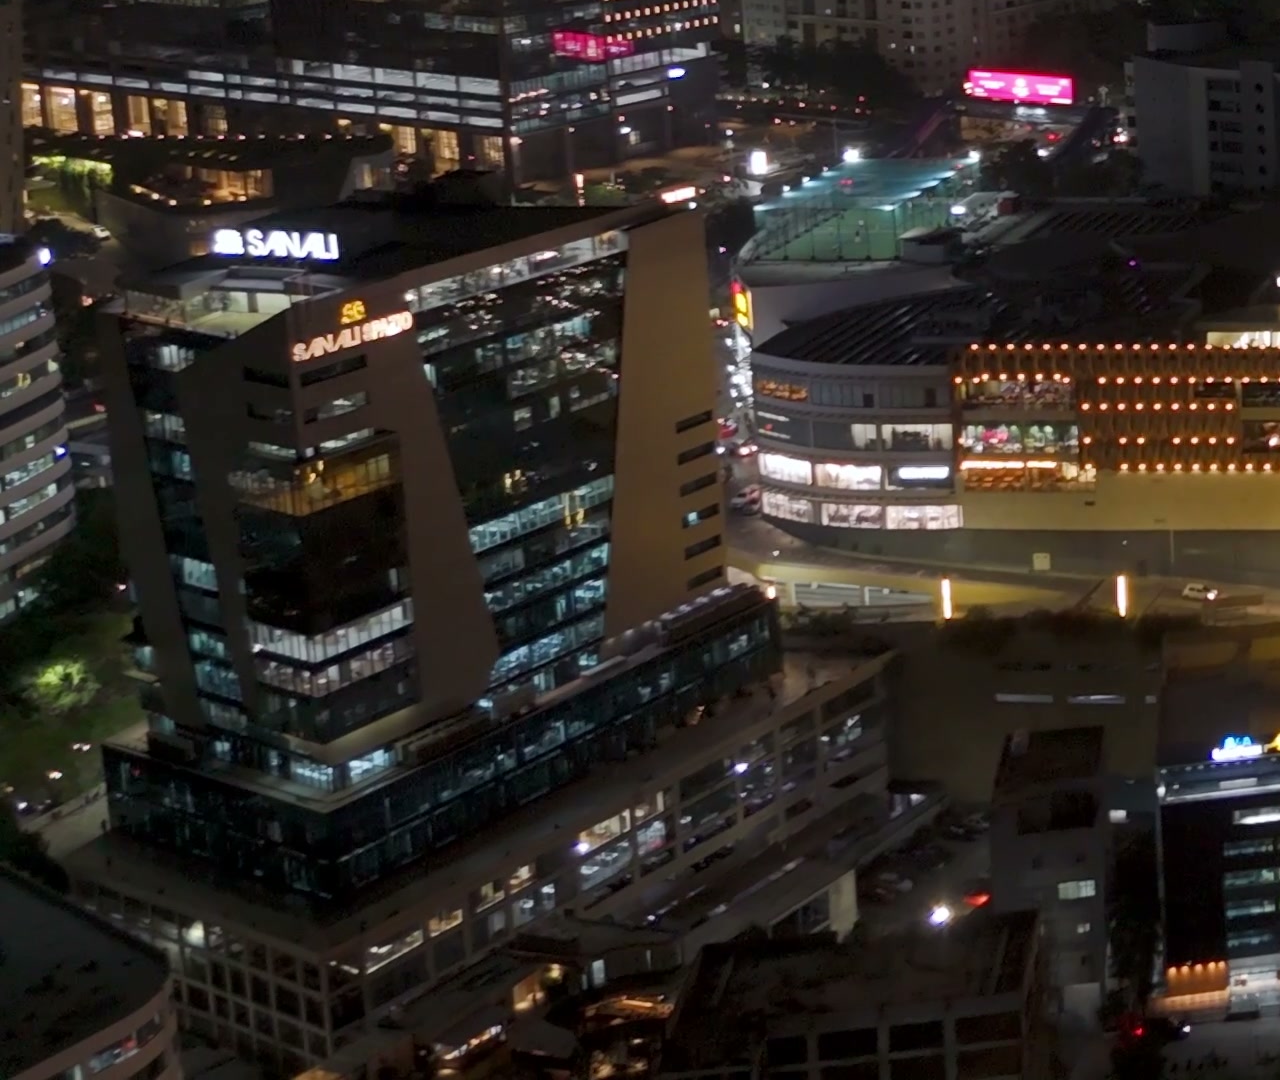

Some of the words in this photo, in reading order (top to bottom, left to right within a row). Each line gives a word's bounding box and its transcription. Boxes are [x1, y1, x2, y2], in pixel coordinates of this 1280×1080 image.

[246, 228, 340, 260] SANALI
[292, 325, 361, 362] SANALI
[361, 310, 414, 342] SPAZIO
